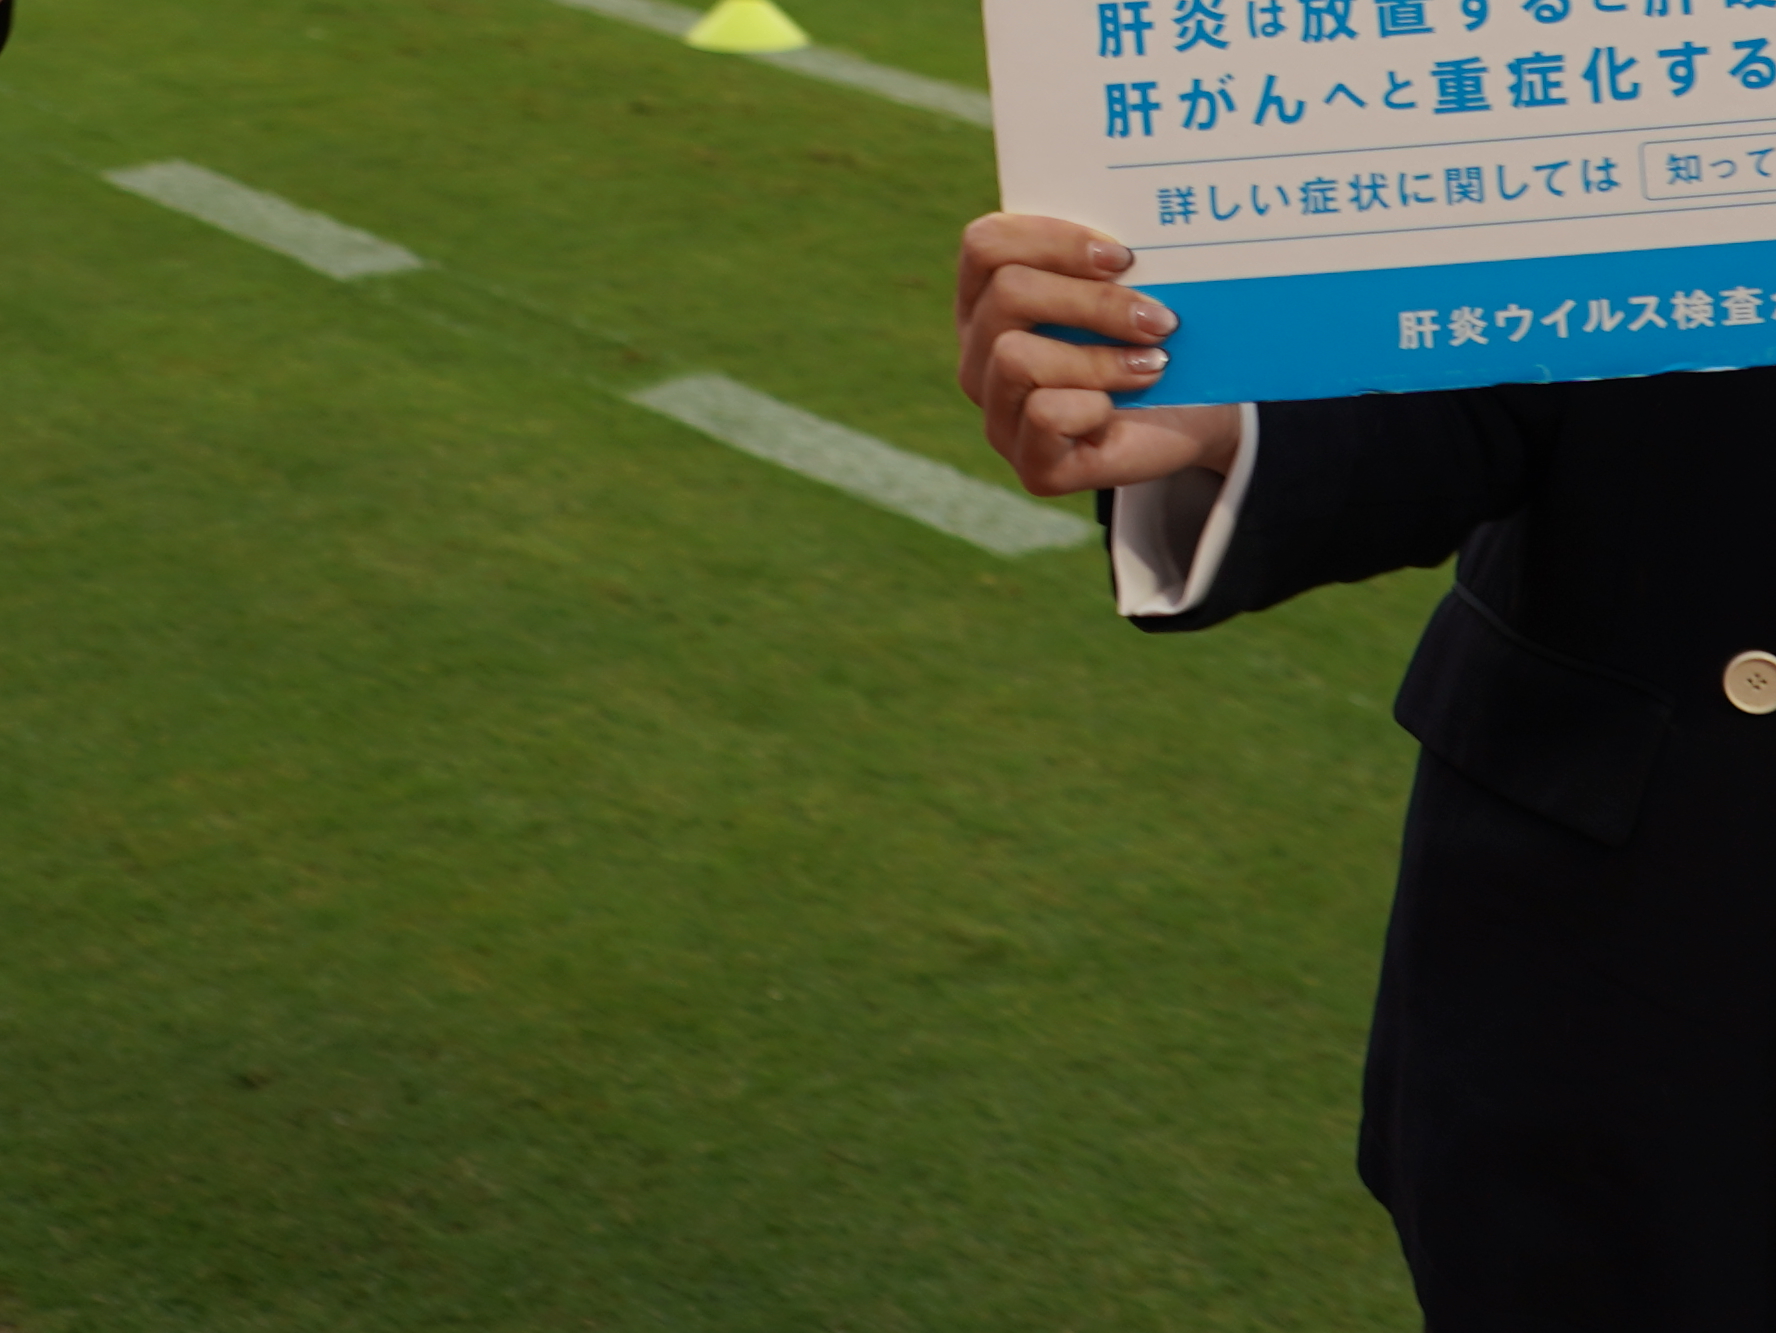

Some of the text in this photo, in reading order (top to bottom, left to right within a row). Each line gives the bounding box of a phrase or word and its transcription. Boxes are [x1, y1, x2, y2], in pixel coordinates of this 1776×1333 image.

[1156, 157, 1622, 226] 詳しい症状に関しては
